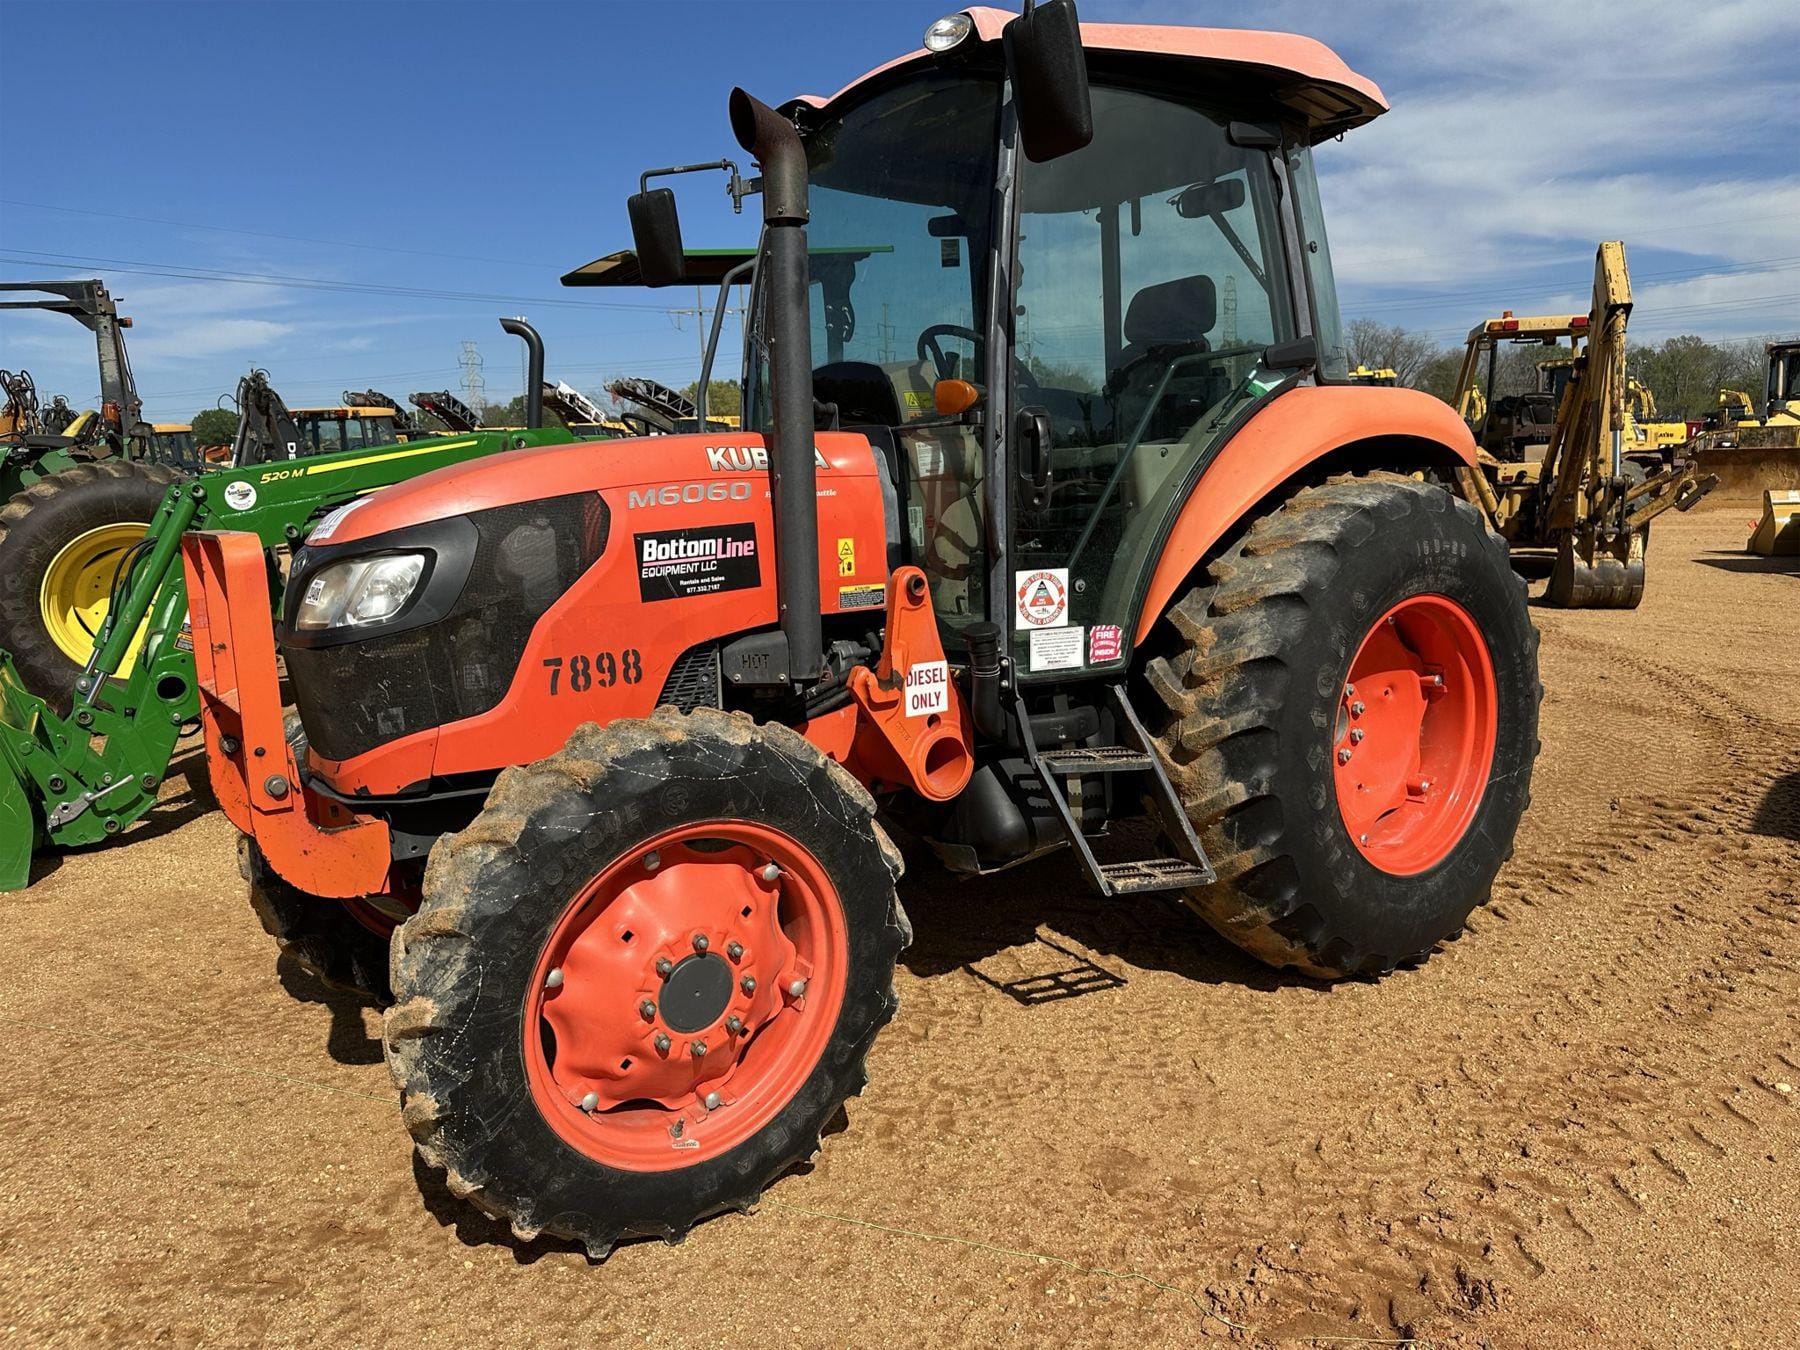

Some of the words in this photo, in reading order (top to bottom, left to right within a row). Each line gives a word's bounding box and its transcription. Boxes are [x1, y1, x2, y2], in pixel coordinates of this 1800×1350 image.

[705, 447, 831, 471] KUBA
[260, 470, 290, 484] 520
[292, 468, 305, 478] M
[628, 482, 752, 509] M6060
[642, 562, 700, 578] EQUIPMENT
[701, 561, 718, 571] LLC
[1096, 631, 1115, 639] FIRE
[742, 654, 770, 669] HOT
[543, 649, 643, 695] 7898
[906, 667, 946, 687] DIESEL
[911, 691, 941, 710] ONLY
